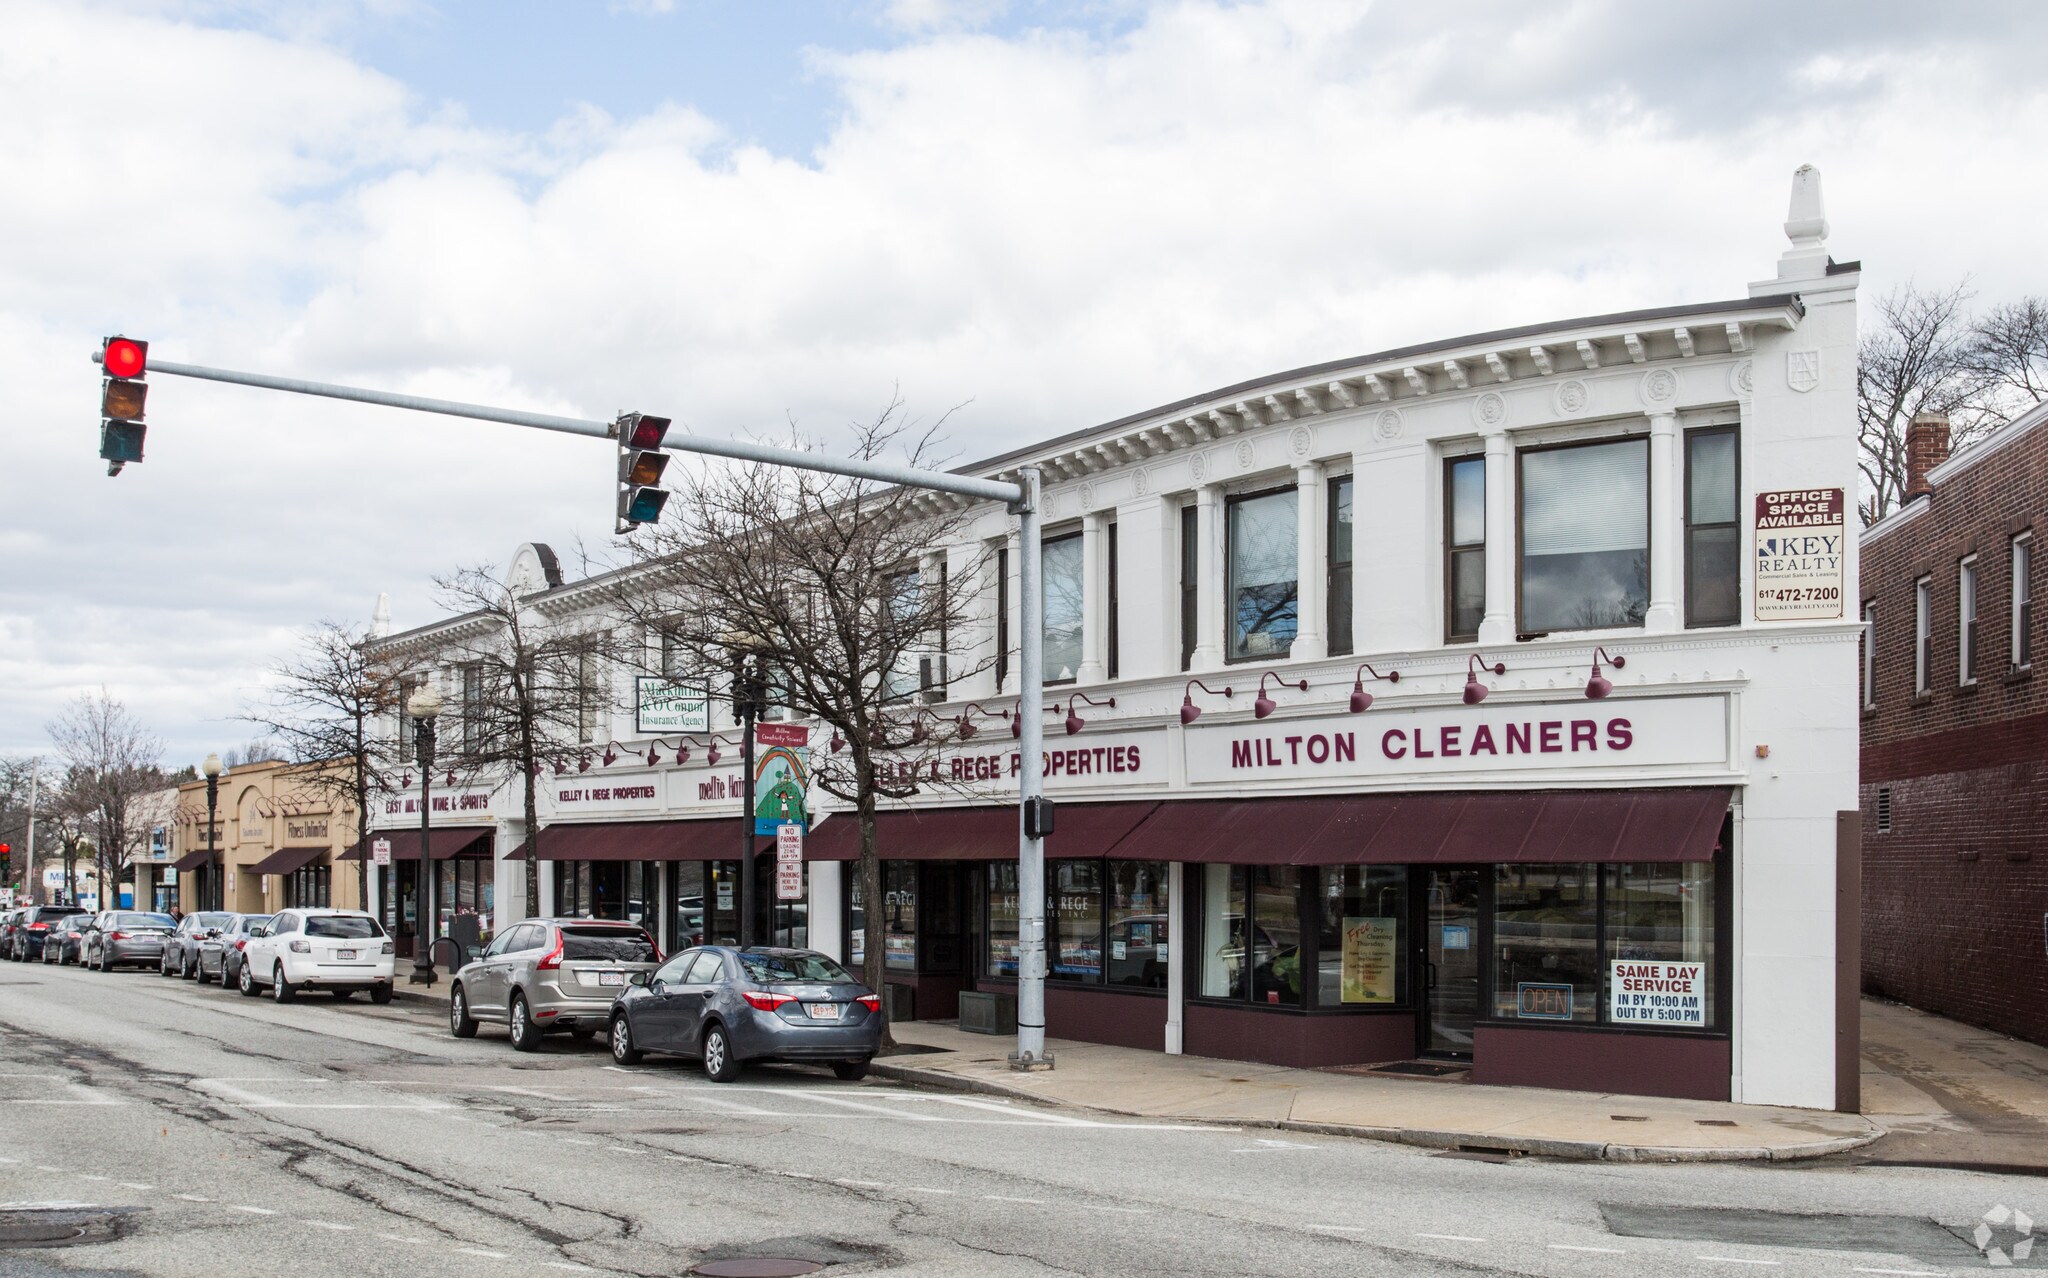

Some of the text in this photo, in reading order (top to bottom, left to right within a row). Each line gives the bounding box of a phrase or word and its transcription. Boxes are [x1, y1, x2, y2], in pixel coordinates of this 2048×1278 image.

[1766, 490, 1832, 504] OFFICE
[1769, 502, 1828, 514] SPACE
[1758, 514, 1842, 528] AVAILABLE
[1759, 557, 1838, 572] REALTY
[1759, 587, 1838, 602] 617 472-7200
[642, 698, 650, 711] &
[642, 714, 704, 728] Insurance Agency
[1232, 718, 1633, 768] MILTON CLEANERS
[872, 746, 1140, 788] ELLEY & REGE POPERTIES
[559, 786, 655, 802] KELLEY & REGE PROPERTIES
[386, 801, 402, 814] EAST
[432, 797, 448, 812] WINE
[452, 796, 456, 810] &
[460, 794, 488, 810] SPIRITS
[288, 821, 328, 838] Fitness Unlimited
[1047, 896, 1054, 910] &
[1061, 896, 1088, 910] REGE
[1347, 923, 1370, 942] Free
[1616, 965, 1699, 980] SAME DAY
[1623, 978, 1692, 993] SERVICE
[1522, 988, 1568, 1014] OPEN
[1618, 994, 1698, 1008] IN BY 10:00 AM
[1616, 1007, 1700, 1022] OUT BY 5:00 PM
